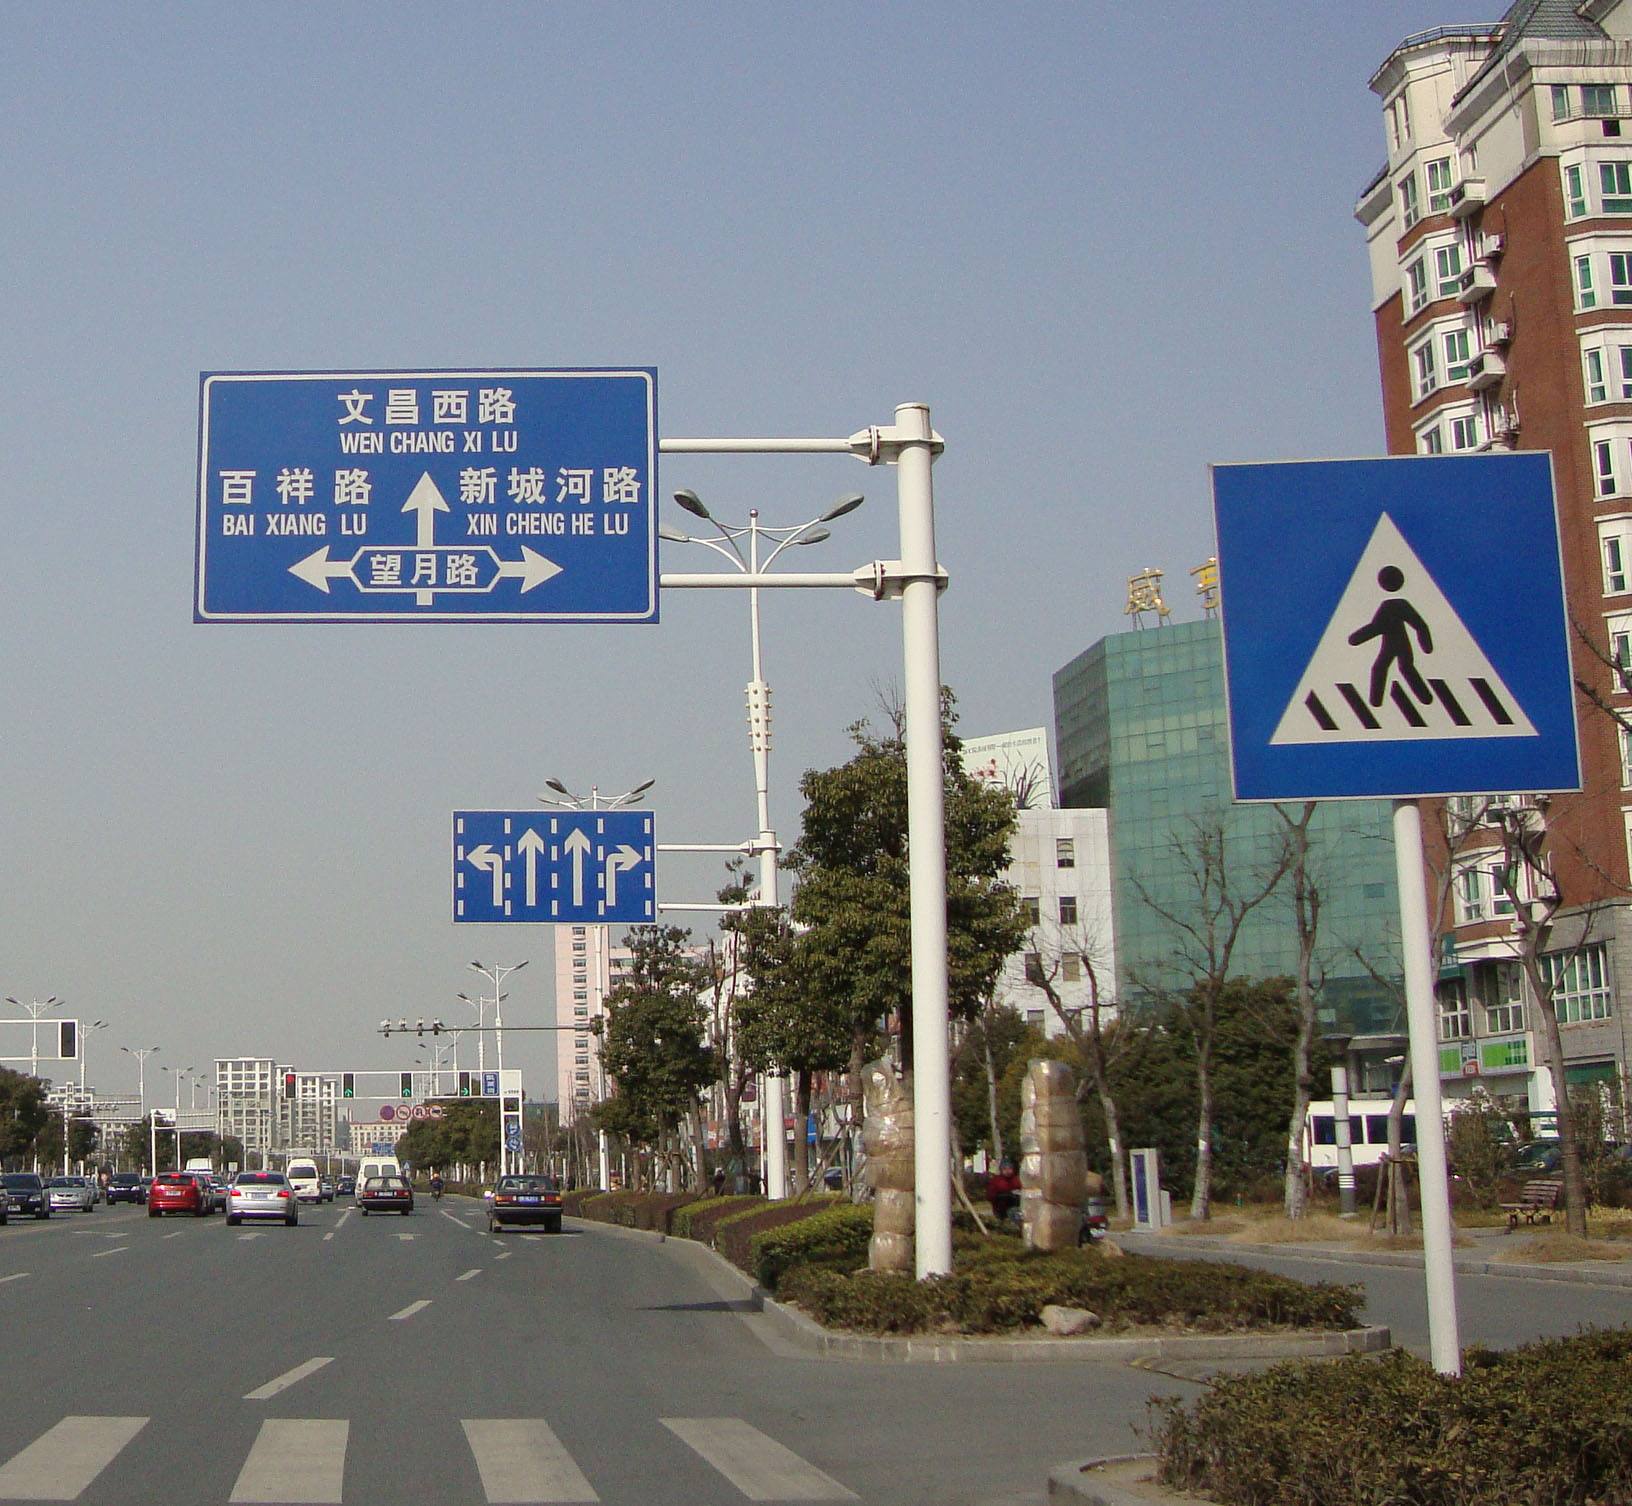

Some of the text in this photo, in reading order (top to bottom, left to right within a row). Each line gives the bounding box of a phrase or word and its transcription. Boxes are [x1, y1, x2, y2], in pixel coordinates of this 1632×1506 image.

[337, 387, 517, 425] 文昌西路
[340, 431, 518, 454] WEN CHANG XI LU
[219, 468, 373, 505] 百祥路
[460, 466, 642, 505] 新城河路
[222, 513, 367, 536] BAI XIANG LU
[467, 513, 629, 535] XIN CHENG HE LU
[370, 553, 479, 586] 望月路
